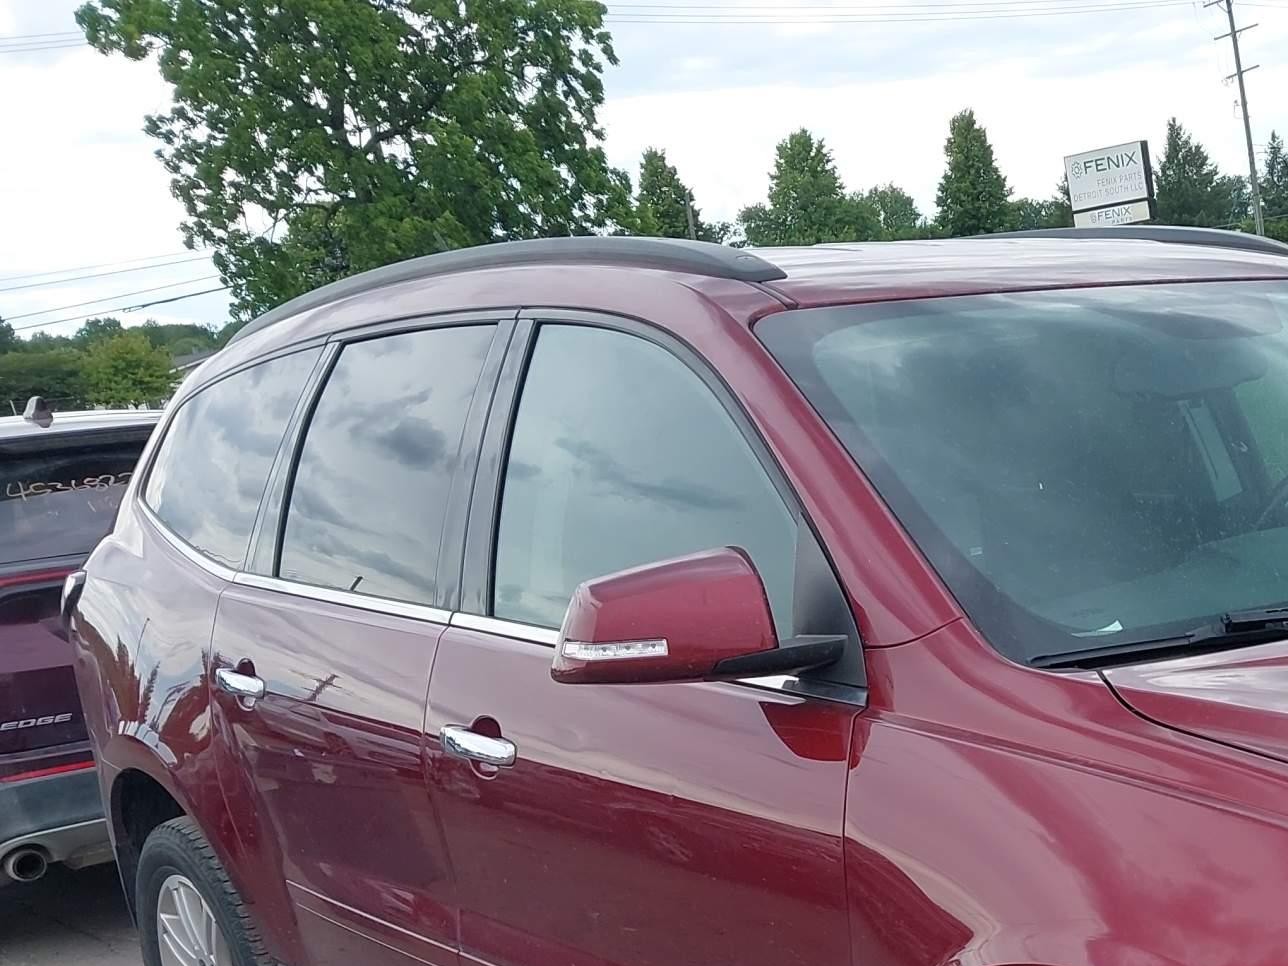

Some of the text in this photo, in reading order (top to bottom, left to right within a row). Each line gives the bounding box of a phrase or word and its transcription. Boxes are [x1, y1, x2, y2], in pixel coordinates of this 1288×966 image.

[1083, 151, 1138, 175] FENIX
[1096, 172, 1142, 187] FENIX PARTS
[1073, 181, 1144, 202] DETROIT SOUTH LLC
[1097, 206, 1132, 221] FENIX
[0, 712, 73, 731] EDGE
